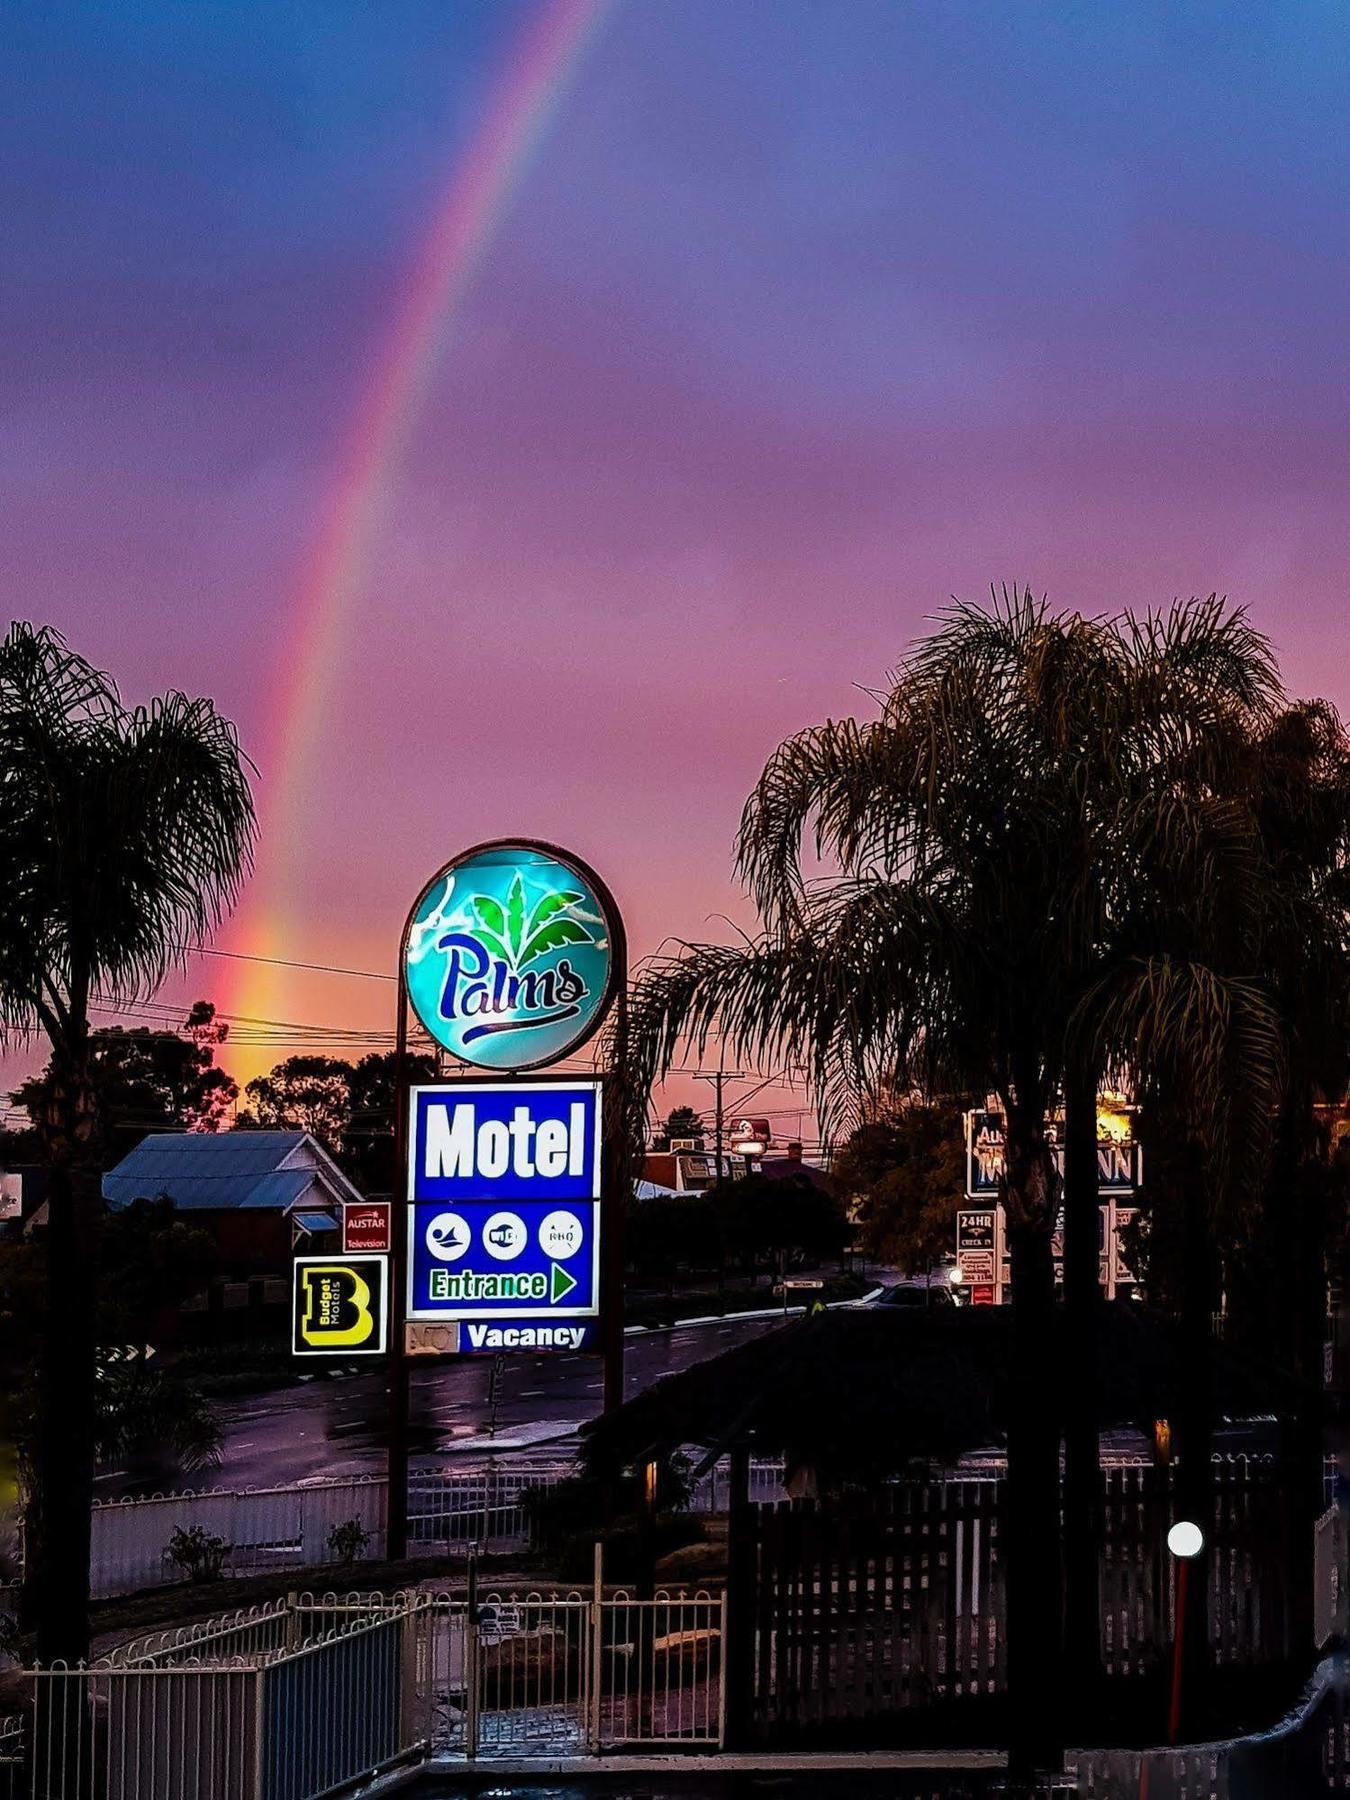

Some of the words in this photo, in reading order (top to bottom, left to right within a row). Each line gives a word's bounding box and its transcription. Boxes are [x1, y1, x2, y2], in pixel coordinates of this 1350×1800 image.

[438, 932, 590, 1019] Palms
[425, 1102, 585, 1178] Motel
[347, 1218, 386, 1229] AUSTAR
[961, 1216, 992, 1227] 24HR
[346, 1238, 386, 1249] Television
[429, 1267, 548, 1301] Entrance
[319, 1278, 332, 1326] Budget
[331, 1281, 341, 1325] Motels
[468, 1323, 587, 1350] Vacancy
